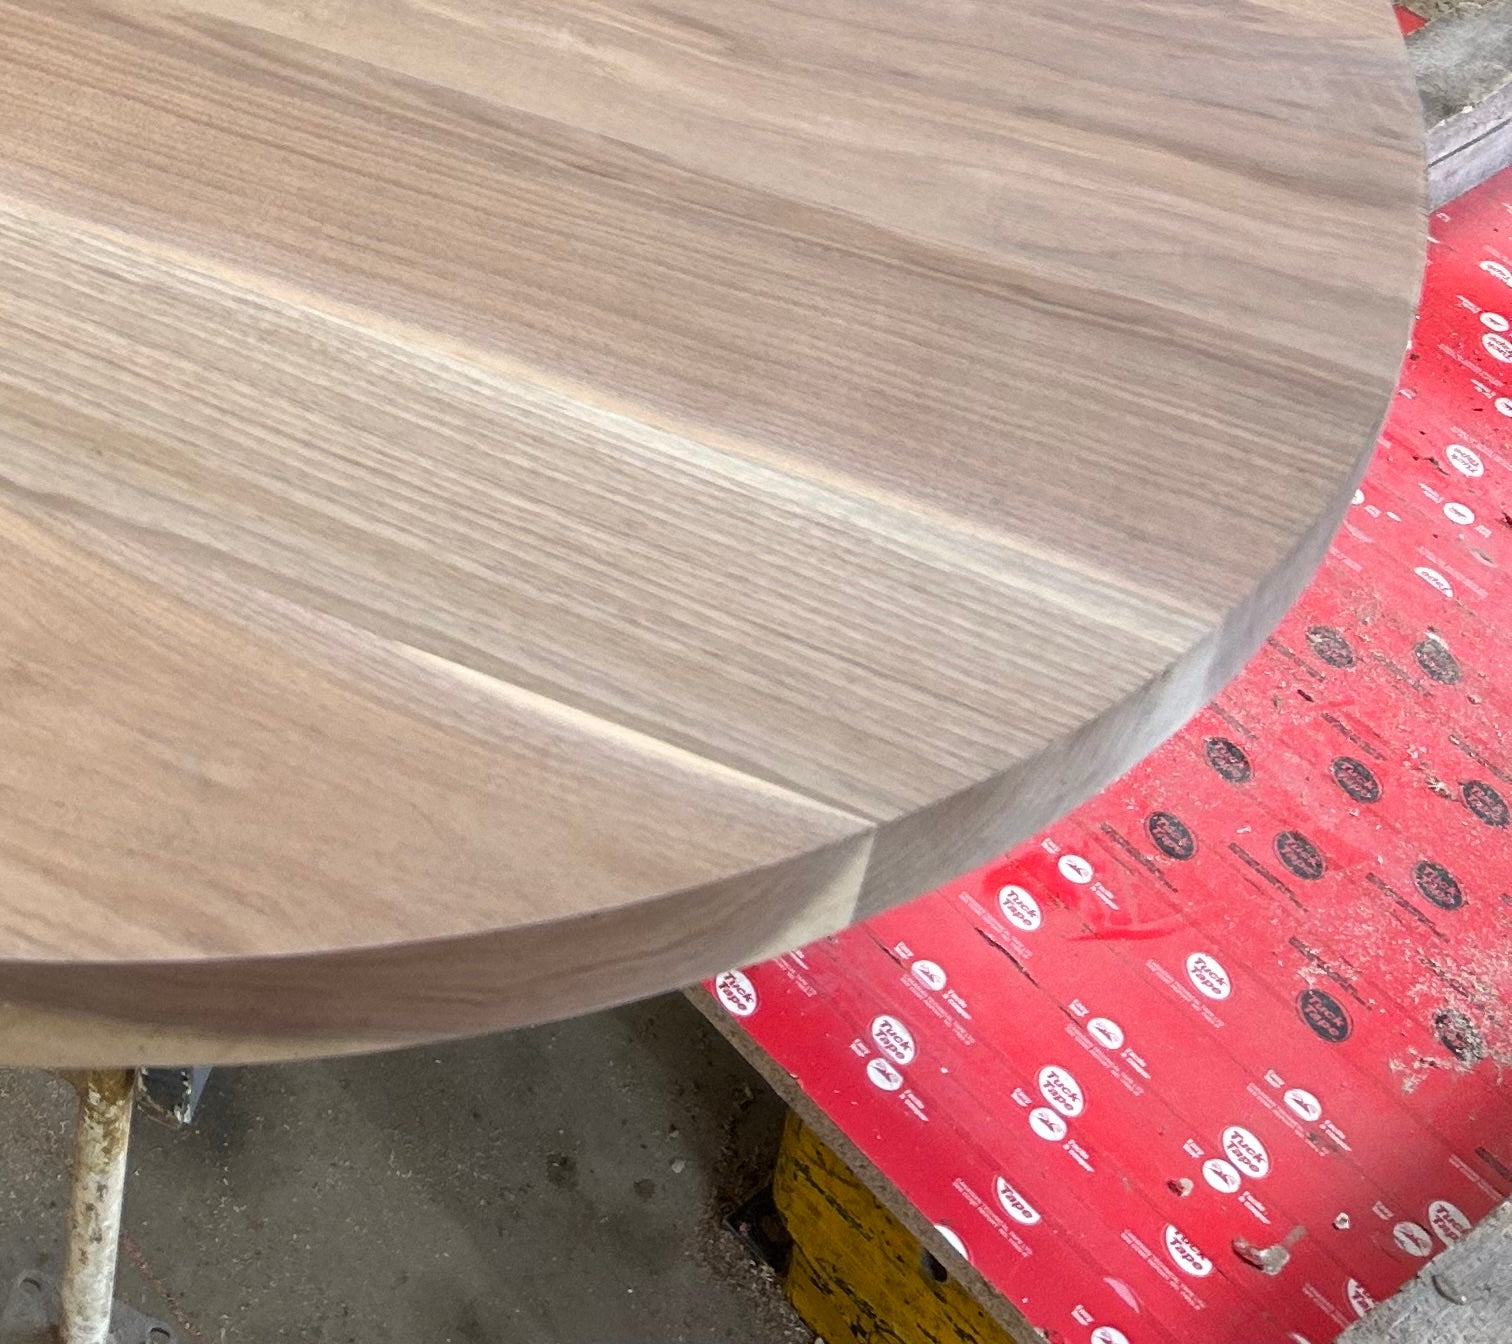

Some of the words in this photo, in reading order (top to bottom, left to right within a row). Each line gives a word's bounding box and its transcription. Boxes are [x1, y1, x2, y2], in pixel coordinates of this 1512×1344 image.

[1002, 897, 1033, 926] Tape
[1007, 889, 1039, 919] Tuck
[724, 972, 755, 1003] Tuck
[1191, 965, 1222, 995] Tape
[1194, 956, 1228, 987] Tuck
[718, 980, 747, 1011] Tape
[1308, 994, 1345, 1027] Tuck
[879, 1018, 913, 1052] Tuck
[1304, 1003, 1340, 1037] Tape
[874, 1027, 906, 1060] Tape
[1042, 1079, 1075, 1111] Tape
[1046, 1070, 1081, 1102] Tuck
[1226, 1140, 1261, 1173] Tape
[1230, 1130, 1266, 1164] Tuck
[1000, 1182, 1033, 1218] Tape
[1169, 1236, 1204, 1270] Tape
